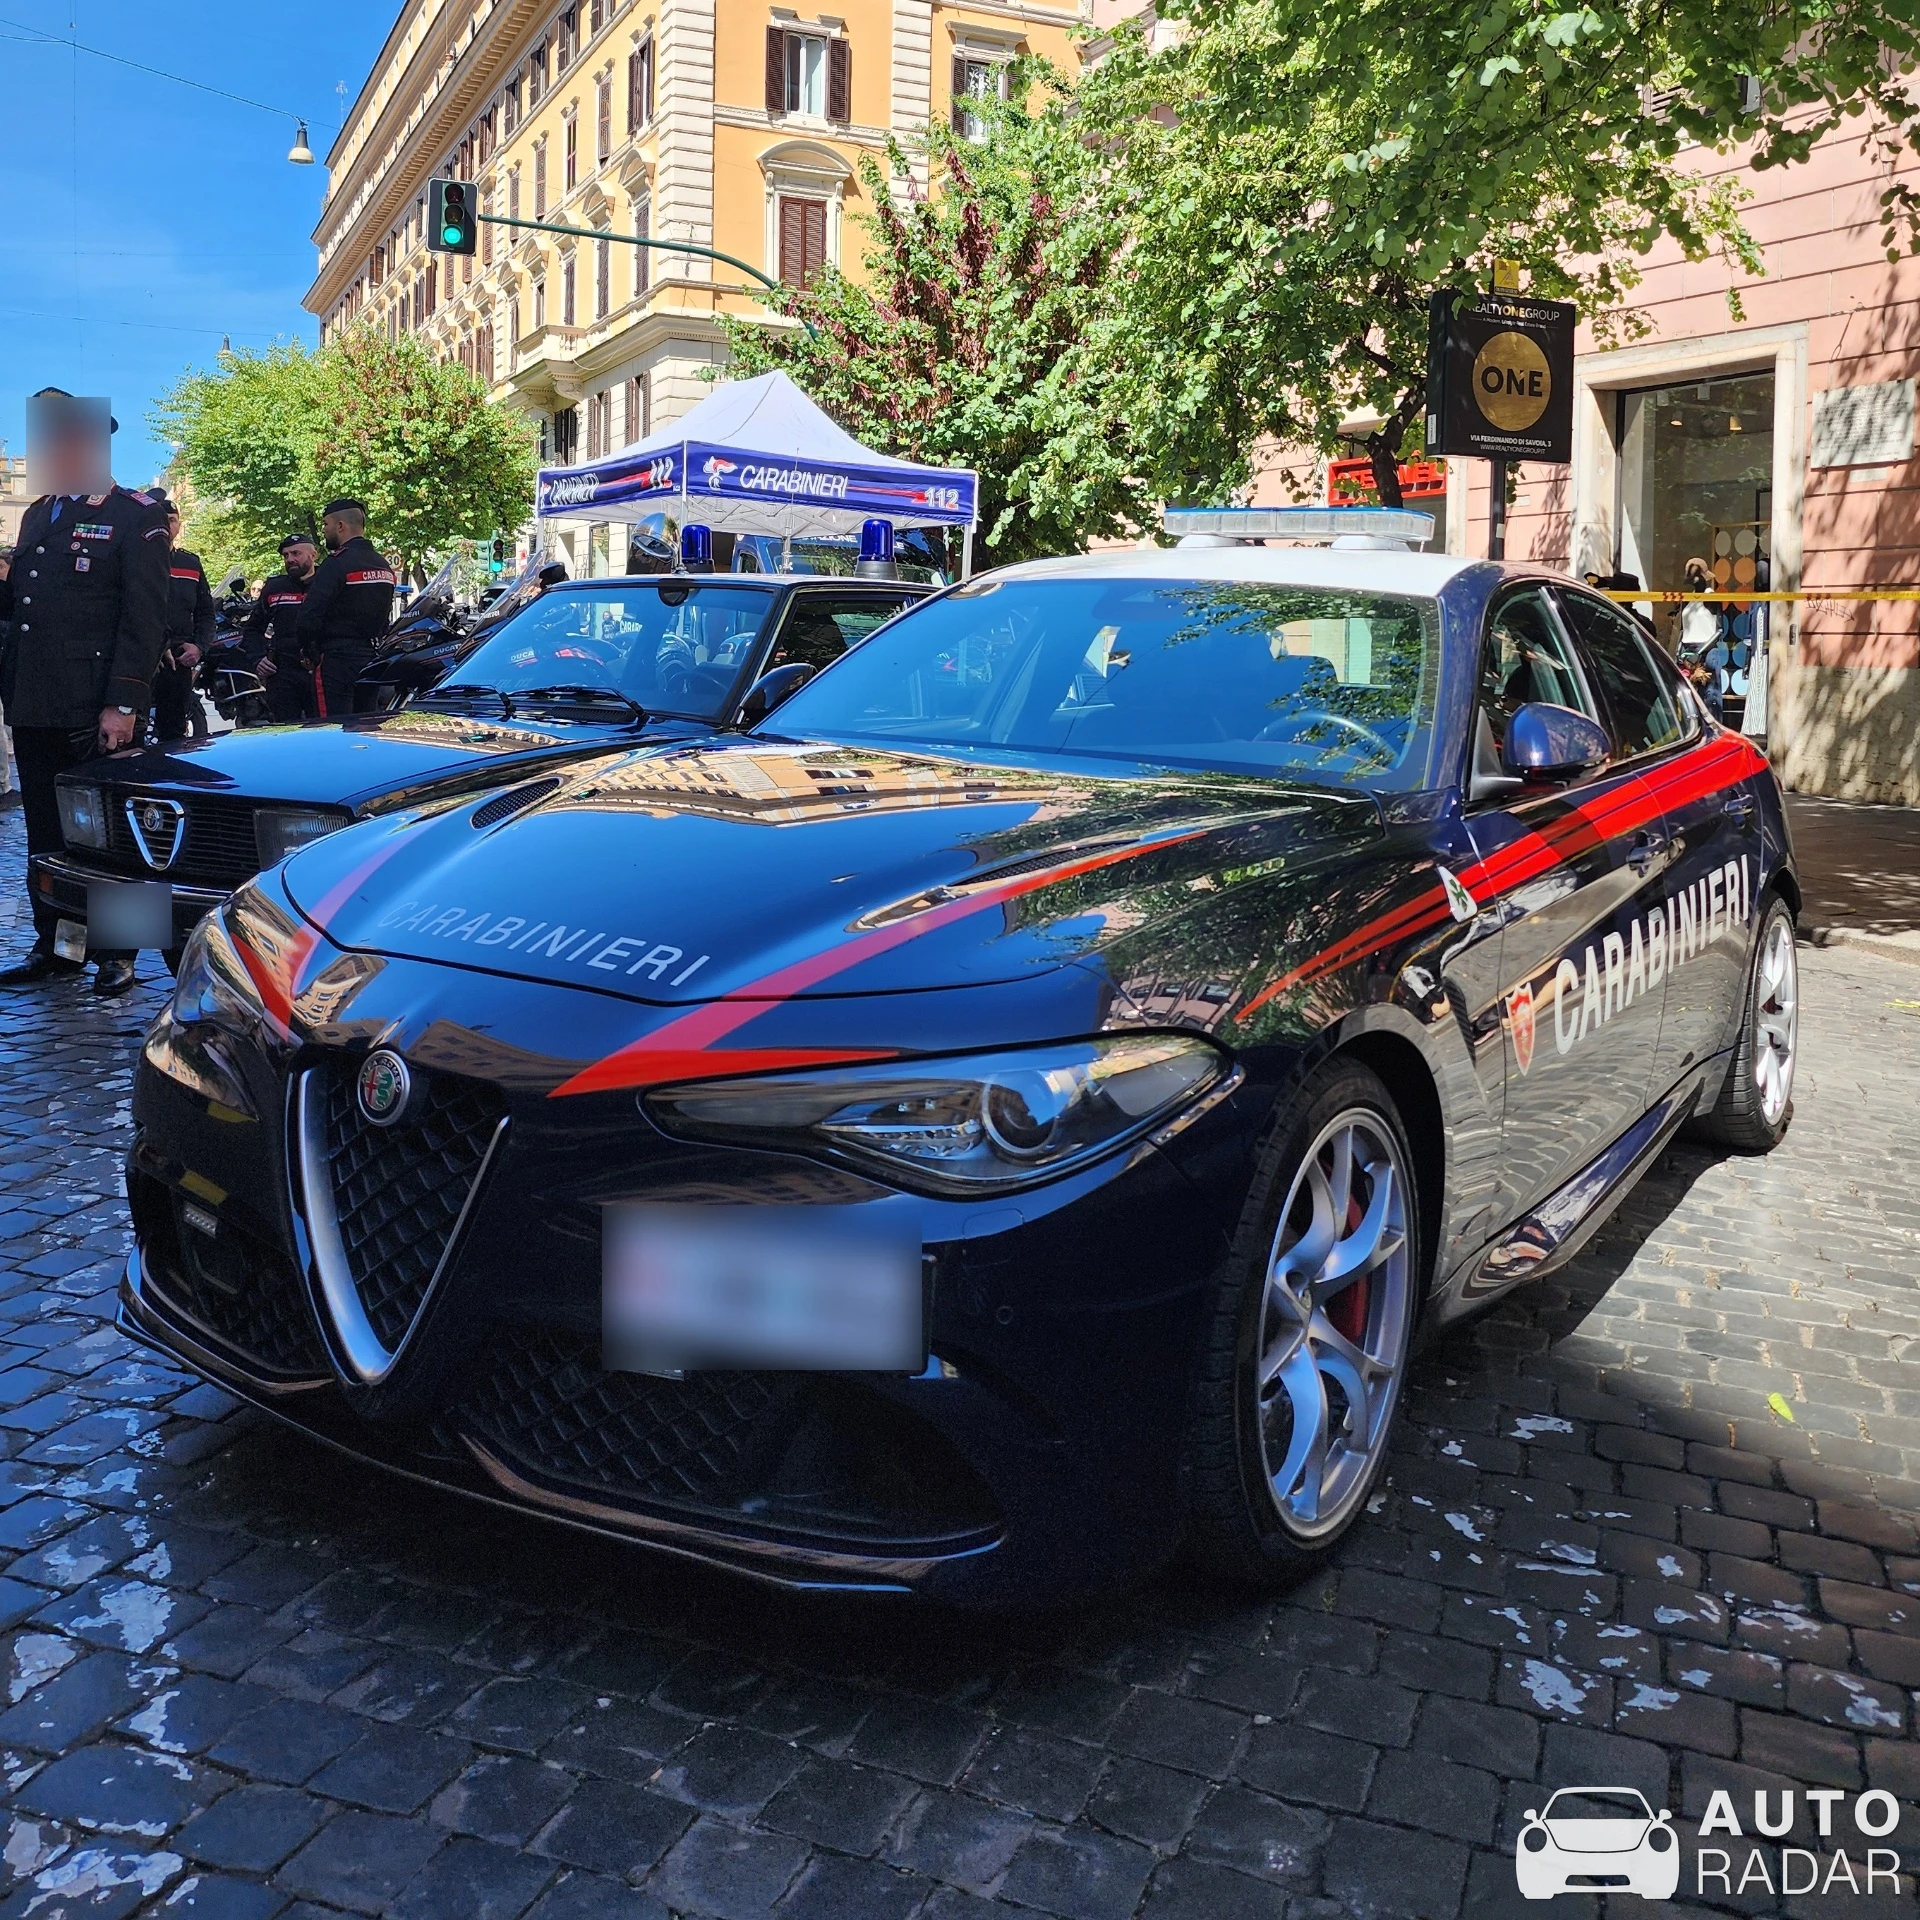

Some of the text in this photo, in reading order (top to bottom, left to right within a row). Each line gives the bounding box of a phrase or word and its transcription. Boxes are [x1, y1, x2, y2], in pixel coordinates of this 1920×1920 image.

[1481, 365, 1543, 398] ONE
[1470, 434, 1480, 442] VIA
[1480, 435, 1518, 445] FERDINANDO
[1518, 438, 1525, 446] DI
[649, 456, 674, 490] 112
[739, 465, 959, 510] CARABINIERI 112
[387, 555, 400, 566] 30
[433, 643, 461, 655] DUCAT
[377, 900, 710, 987] CARABINIERI
[1554, 854, 1750, 1055] CARABINIERI
